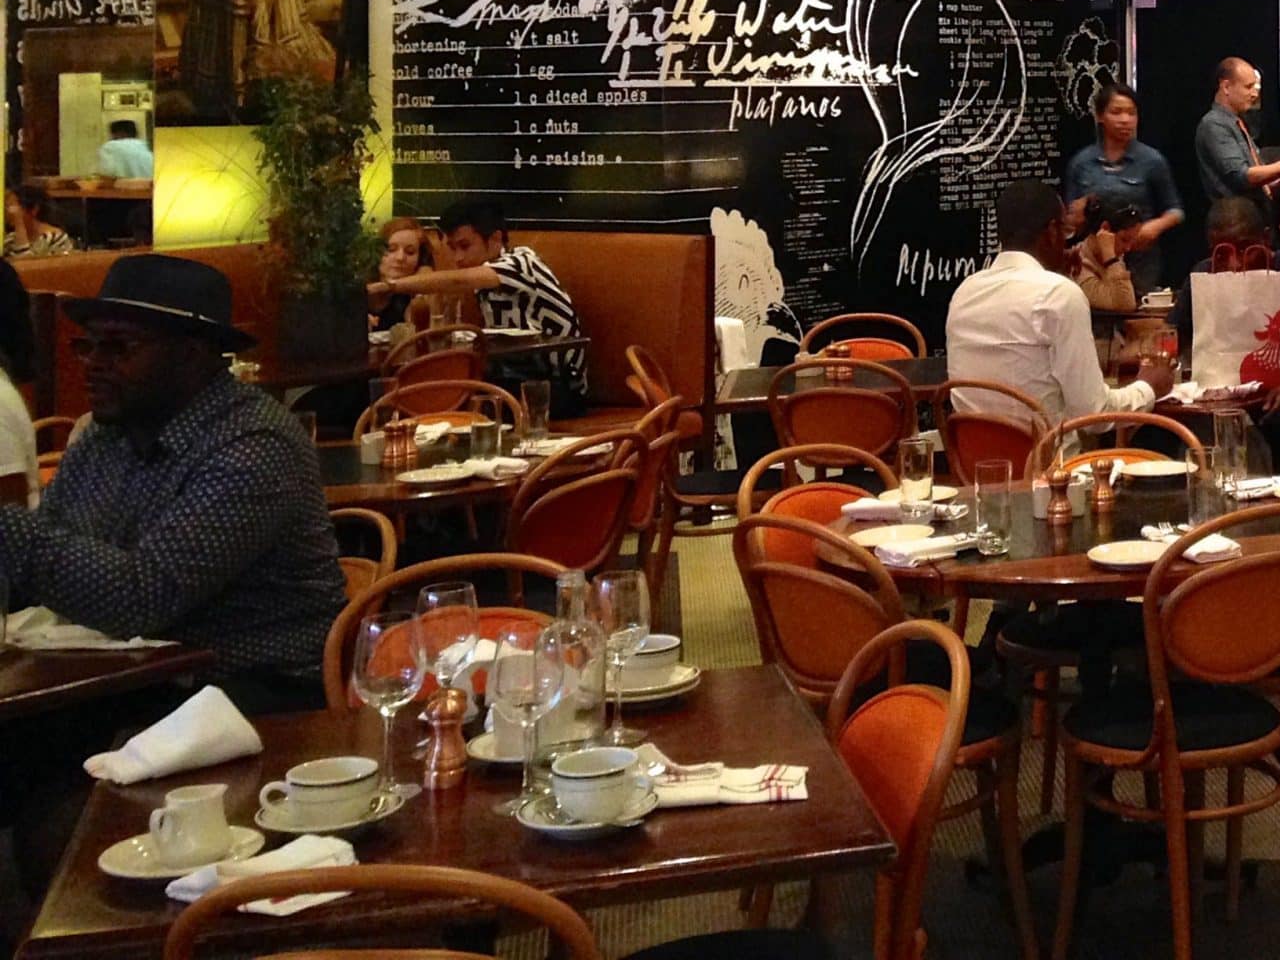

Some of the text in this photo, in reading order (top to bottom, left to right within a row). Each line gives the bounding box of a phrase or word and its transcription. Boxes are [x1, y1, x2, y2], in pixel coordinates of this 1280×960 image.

[545, 30, 579, 46] salt
[426, 61, 474, 78] coffee
[529, 65, 556, 80] egg
[396, 92, 436, 107] flour
[546, 88, 588, 105] diced
[729, 84, 842, 132] platanos
[545, 118, 580, 134] nuts
[545, 150, 605, 166] raisins
